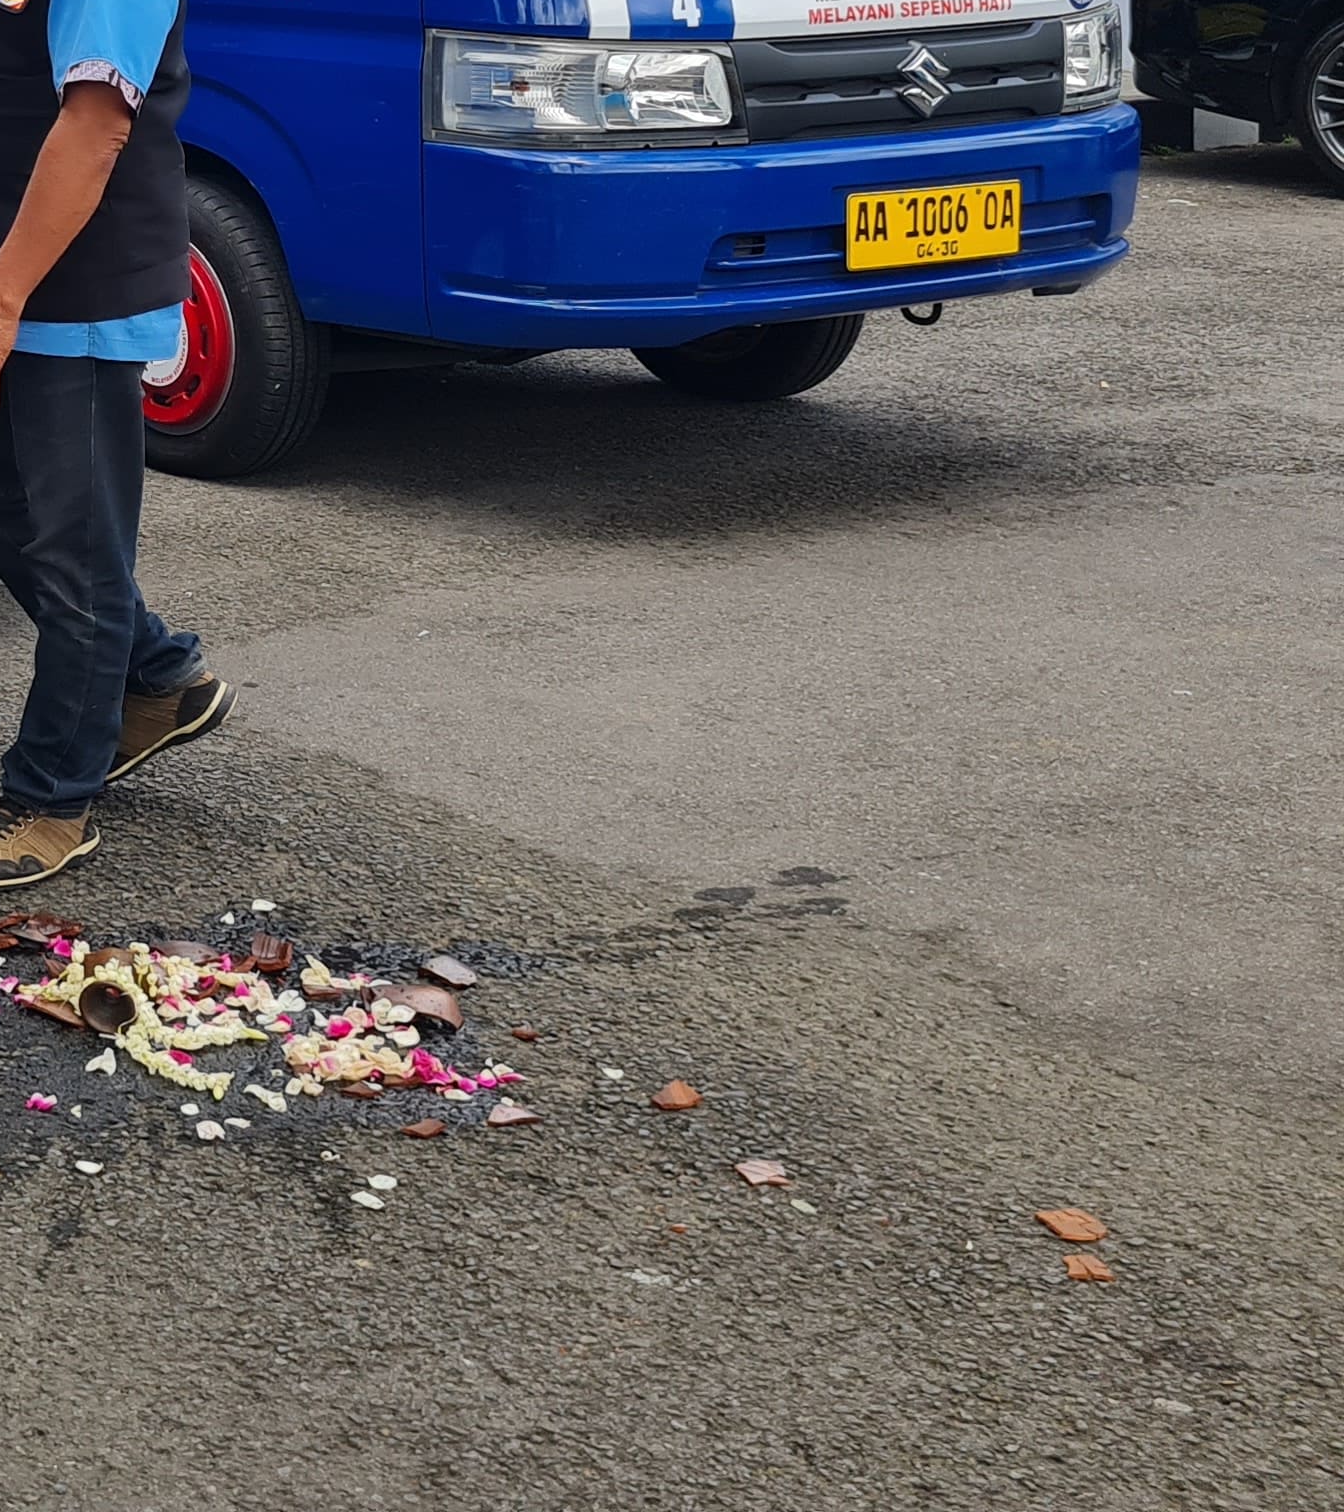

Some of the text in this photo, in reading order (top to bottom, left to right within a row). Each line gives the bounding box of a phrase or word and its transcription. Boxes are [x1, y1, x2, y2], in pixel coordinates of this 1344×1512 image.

[808, 3, 895, 25] MELAYANI
[855, 201, 889, 242] AA
[905, 193, 969, 238] 1006
